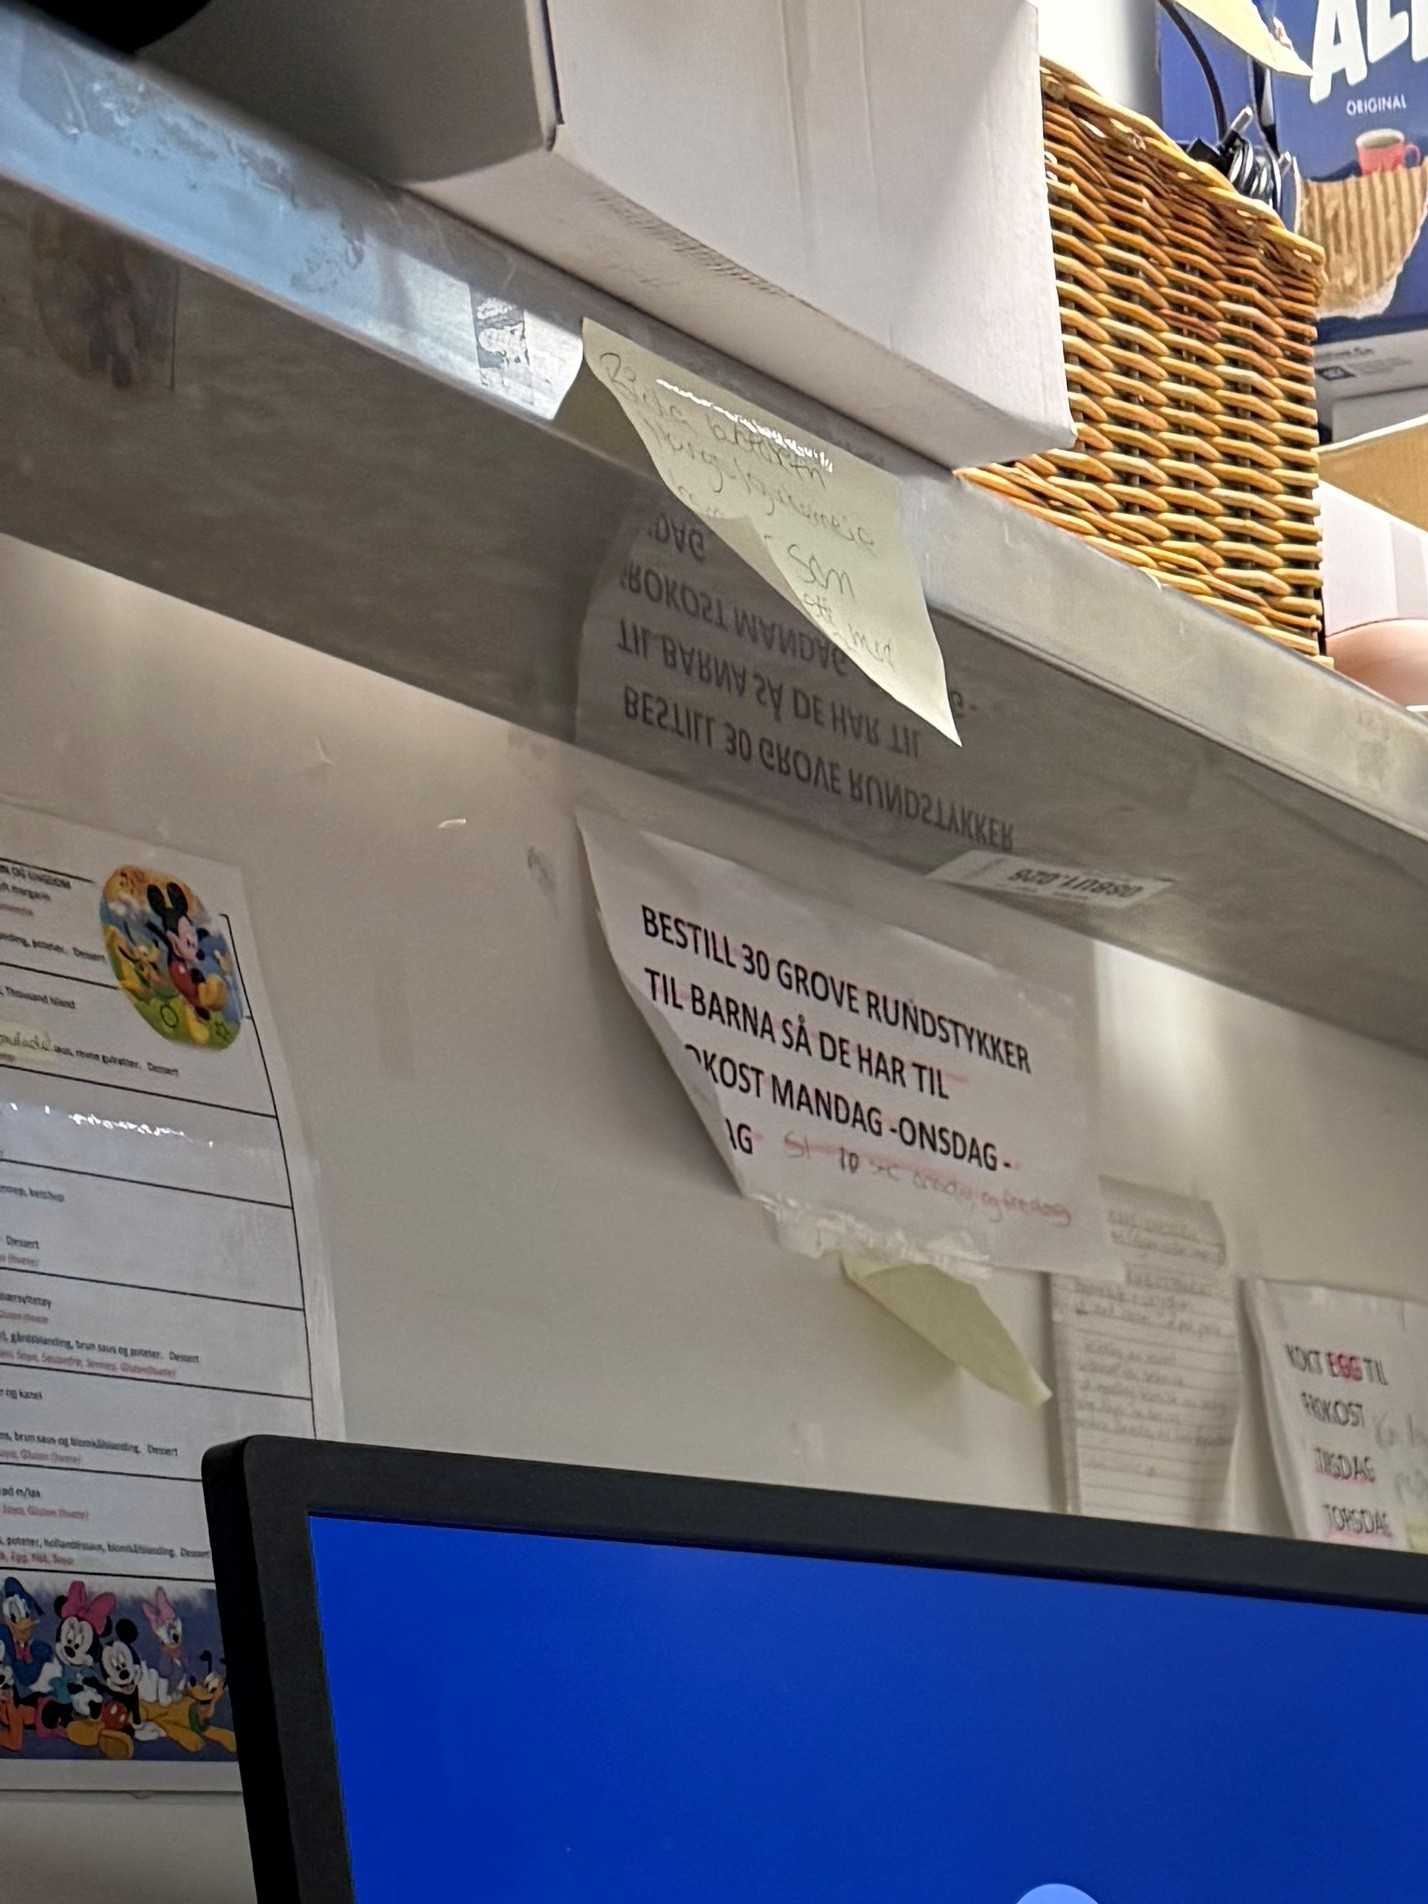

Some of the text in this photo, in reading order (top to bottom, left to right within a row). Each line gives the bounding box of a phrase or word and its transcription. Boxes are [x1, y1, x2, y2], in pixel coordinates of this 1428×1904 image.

[1346, 97, 1408, 117] ORIGINAL
[641, 905, 1032, 1075] BESTILL 30 GROVE RUNDSTYKKER
[644, 967, 950, 1101] TIL BARNA SÅ DE HAR TIL
[684, 1043, 765, 1099] KOST
[771, 1073, 883, 1138] MANDAG
[1327, 1351, 1363, 1381] EGG
